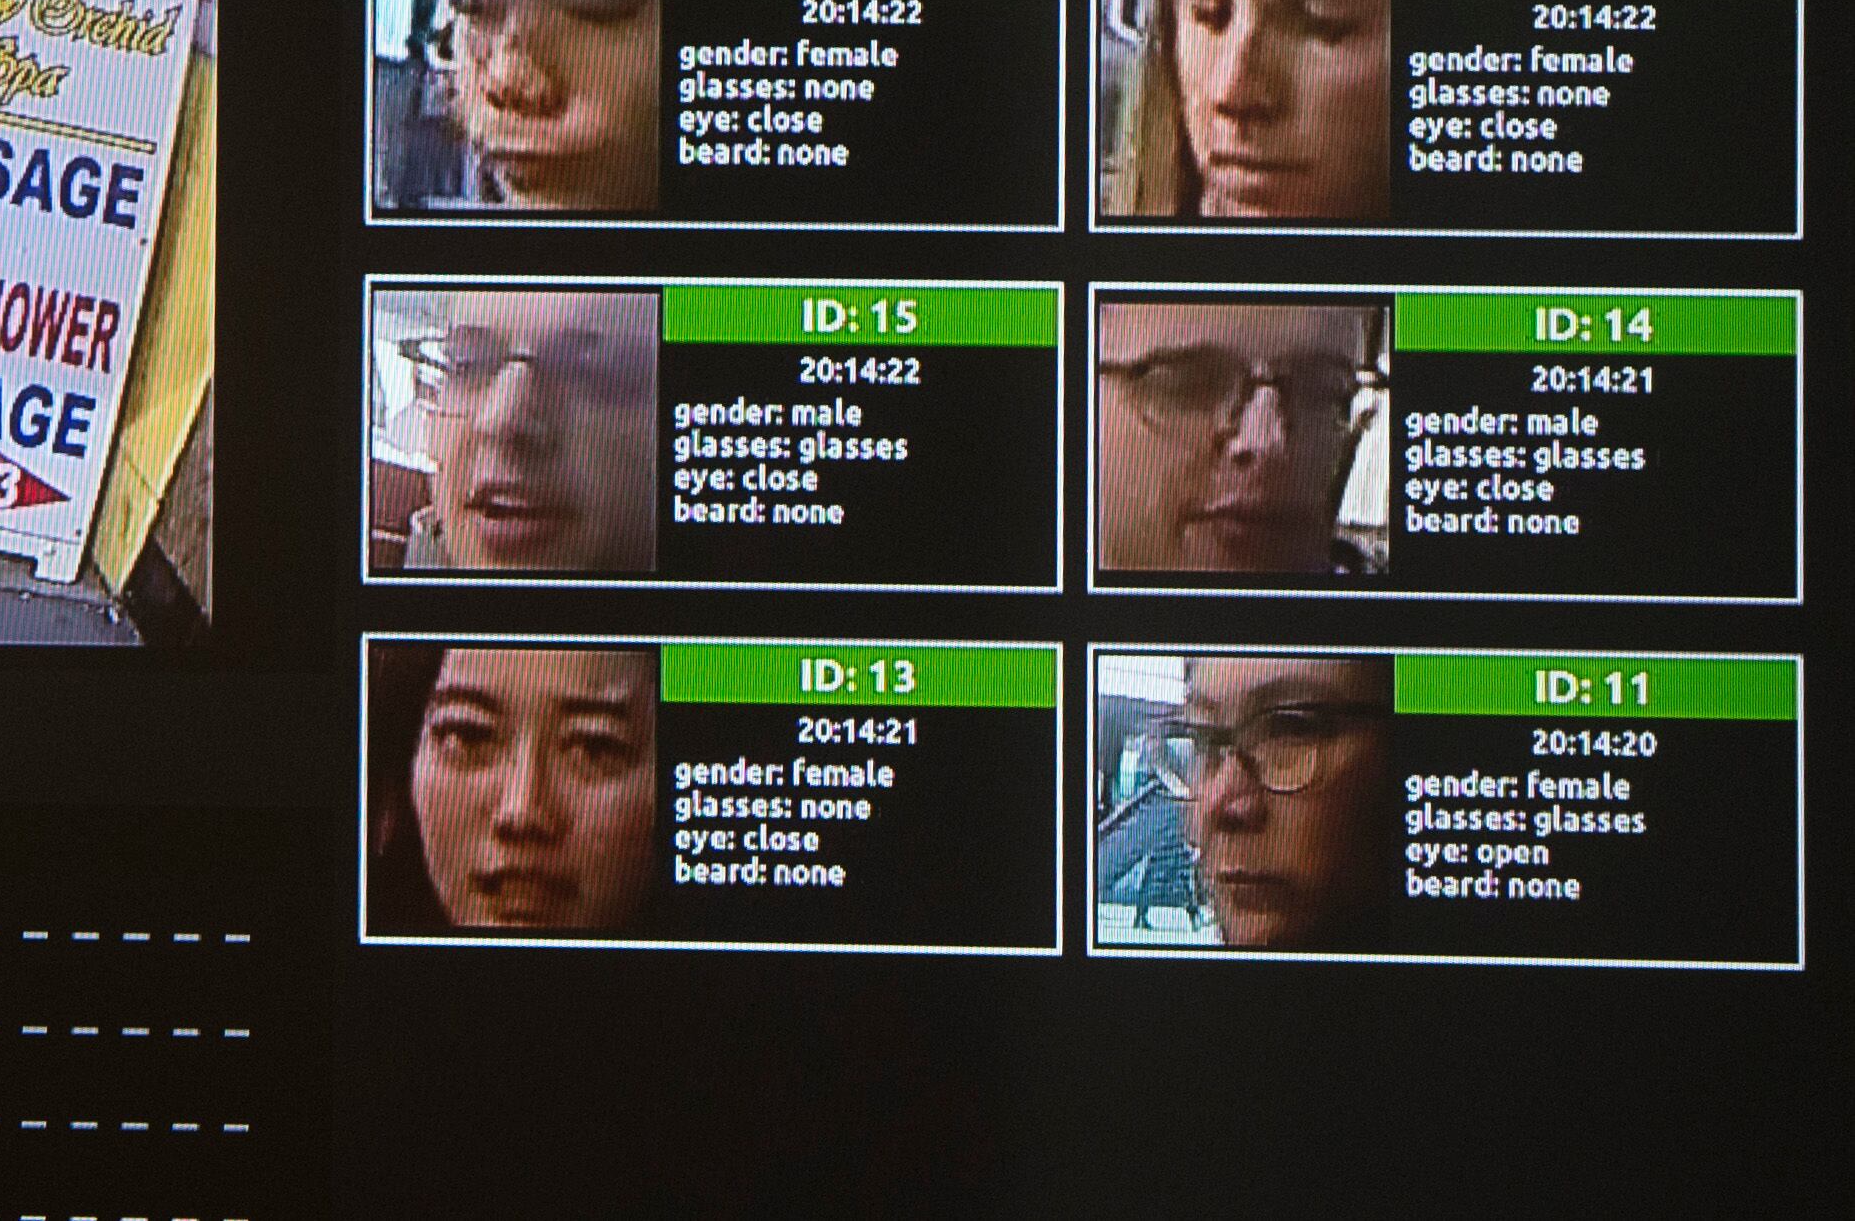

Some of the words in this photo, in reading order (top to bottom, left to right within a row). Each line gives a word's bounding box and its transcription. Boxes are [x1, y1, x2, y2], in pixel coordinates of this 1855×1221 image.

[1531, 3, 1657, 31] 20:14:22
[677, 38, 788, 72] gender:
[795, 38, 900, 68] female
[1408, 44, 1522, 77] gender:
[1529, 44, 1634, 74] female
[677, 70, 796, 104] glasses:
[804, 78, 875, 102] none
[1408, 76, 1531, 110] glasses:
[1536, 85, 1611, 108] none
[677, 110, 740, 138] eye:
[746, 102, 823, 134] close
[1407, 116, 1472, 145] eye:
[1479, 109, 1558, 141] close
[678, 135, 771, 166] beard:
[776, 143, 850, 167] none
[1407, 142, 1503, 173] beard:
[1510, 150, 1583, 174] none
[802, 295, 860, 334] ID:
[870, 296, 919, 334] 15
[1535, 305, 1593, 342] ID:
[1604, 306, 1655, 343] 14
[799, 355, 922, 386] 20:14:22
[1530, 364, 1653, 394] 20:14:21
[673, 395, 785, 431] gender:
[791, 396, 862, 428] male
[1404, 405, 1519, 440] gender:
[1526, 406, 1599, 437] male
[672, 428, 791, 463] glasses:
[797, 429, 909, 465] glasses
[1404, 438, 1527, 473] glasses:
[1532, 439, 1647, 475] glasses
[673, 467, 736, 496] eye:
[740, 462, 819, 493] close
[1404, 477, 1468, 506] eye:
[1474, 472, 1555, 502] close
[673, 494, 766, 524] beard:
[771, 503, 845, 525] none
[1405, 504, 1499, 534] beard:
[1506, 513, 1580, 535] none
[800, 657, 858, 693] ID:
[868, 658, 920, 694] 13
[1535, 669, 1593, 705] ID:
[1604, 670, 1649, 706] 11
[796, 715, 917, 746] 20:14:21
[1532, 728, 1658, 758] 20:14:20
[673, 756, 784, 791] gender:
[791, 756, 896, 789] female
[1404, 768, 1519, 803] gender:
[1526, 769, 1631, 801] female
[673, 789, 792, 823] glasses:
[799, 798, 872, 821] none
[1404, 802, 1527, 836] glasses:
[1533, 803, 1647, 838] glasses
[673, 829, 736, 856] eye:
[743, 822, 820, 853] close
[1404, 842, 1468, 869] eye:
[1474, 843, 1550, 870] open
[674, 854, 767, 887] beard:
[773, 863, 847, 888] none
[1405, 867, 1499, 899] beard:
[1507, 877, 1582, 901] none
